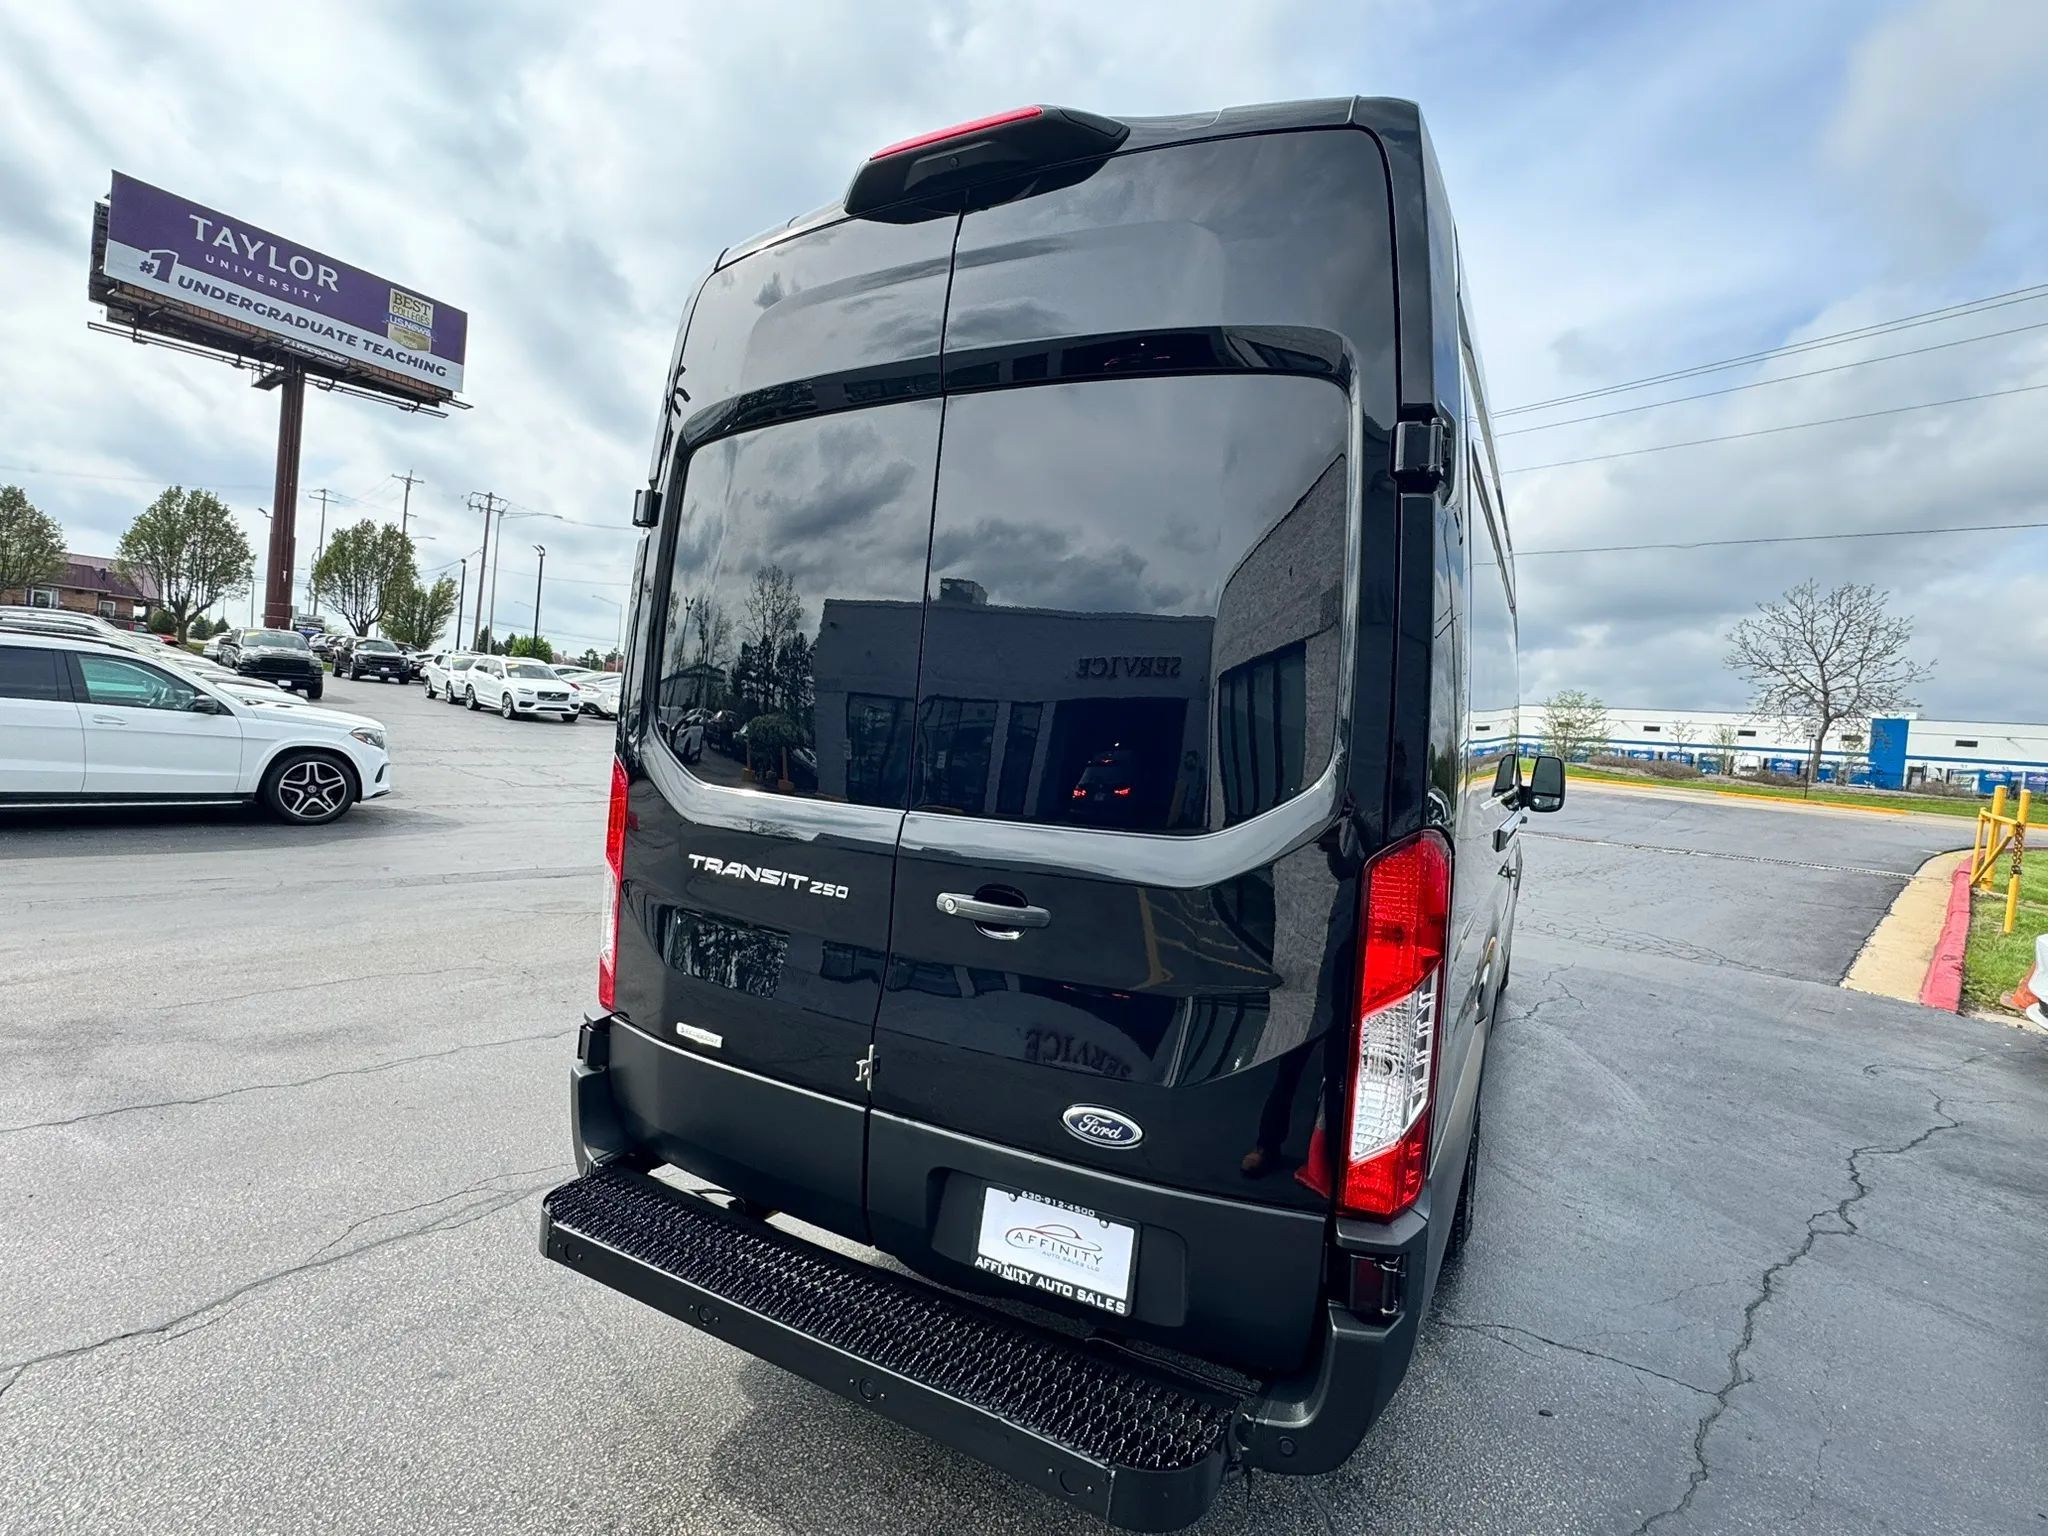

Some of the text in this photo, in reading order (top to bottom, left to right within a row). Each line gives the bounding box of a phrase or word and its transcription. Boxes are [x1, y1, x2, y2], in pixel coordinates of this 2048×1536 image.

[189, 214, 338, 293] TAYLOR
[205, 254, 322, 302] UNIVERSITY
[139, 250, 175, 284] #1
[177, 275, 356, 346] UNDERGRADUATE
[363, 339, 447, 376] TEACHING
[392, 305, 430, 326] COLLEGES
[393, 291, 431, 316] BEST
[688, 854, 849, 899] TRANSIT 250
[1078, 1114, 1122, 1139] Ford
[1021, 1190, 1095, 1217] 630-912-4500
[1014, 1232, 1103, 1265] AFFINITY
[1042, 1251, 1060, 1260] AUTO
[975, 1256, 1126, 1314] AFFINITY AUTO SALES
